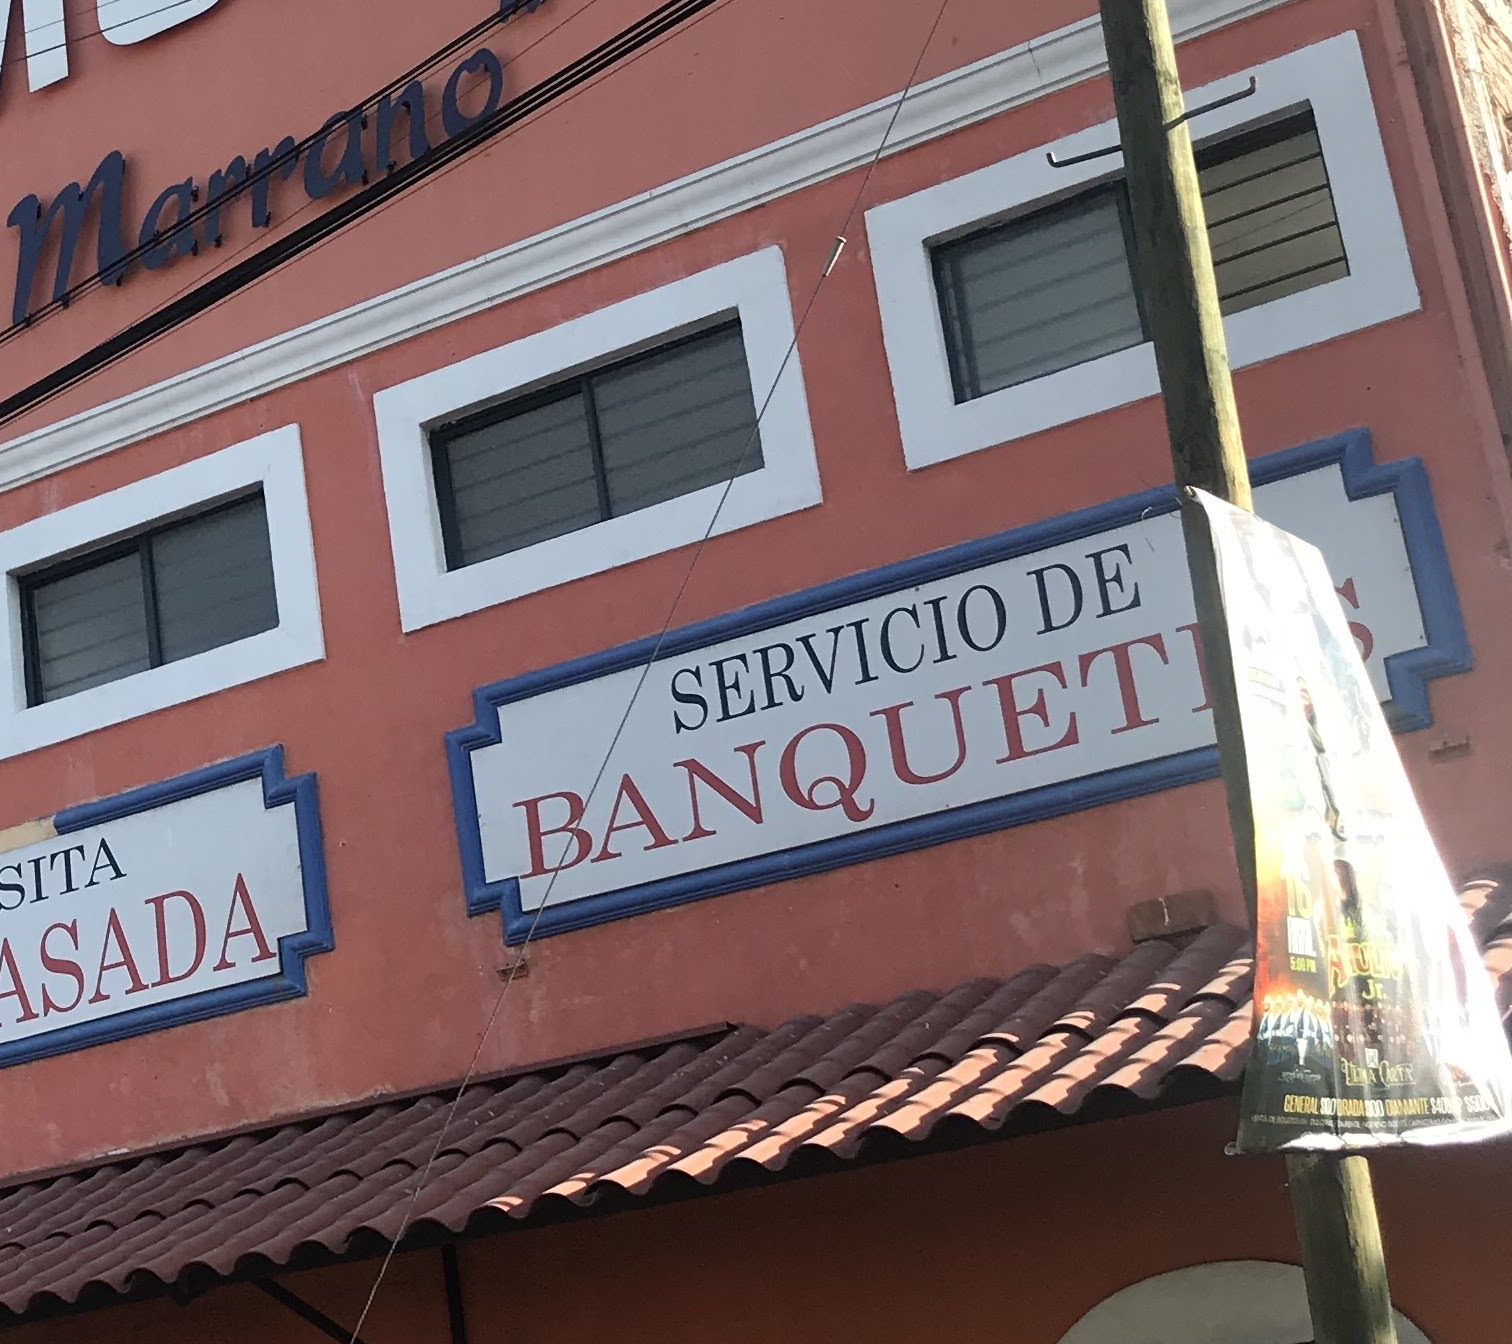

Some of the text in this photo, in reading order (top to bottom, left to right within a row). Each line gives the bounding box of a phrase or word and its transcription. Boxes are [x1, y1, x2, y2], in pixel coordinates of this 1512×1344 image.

[669, 542, 1143, 735] SERVICIO DE
[1283, 1094, 1319, 1115] GENERAL
